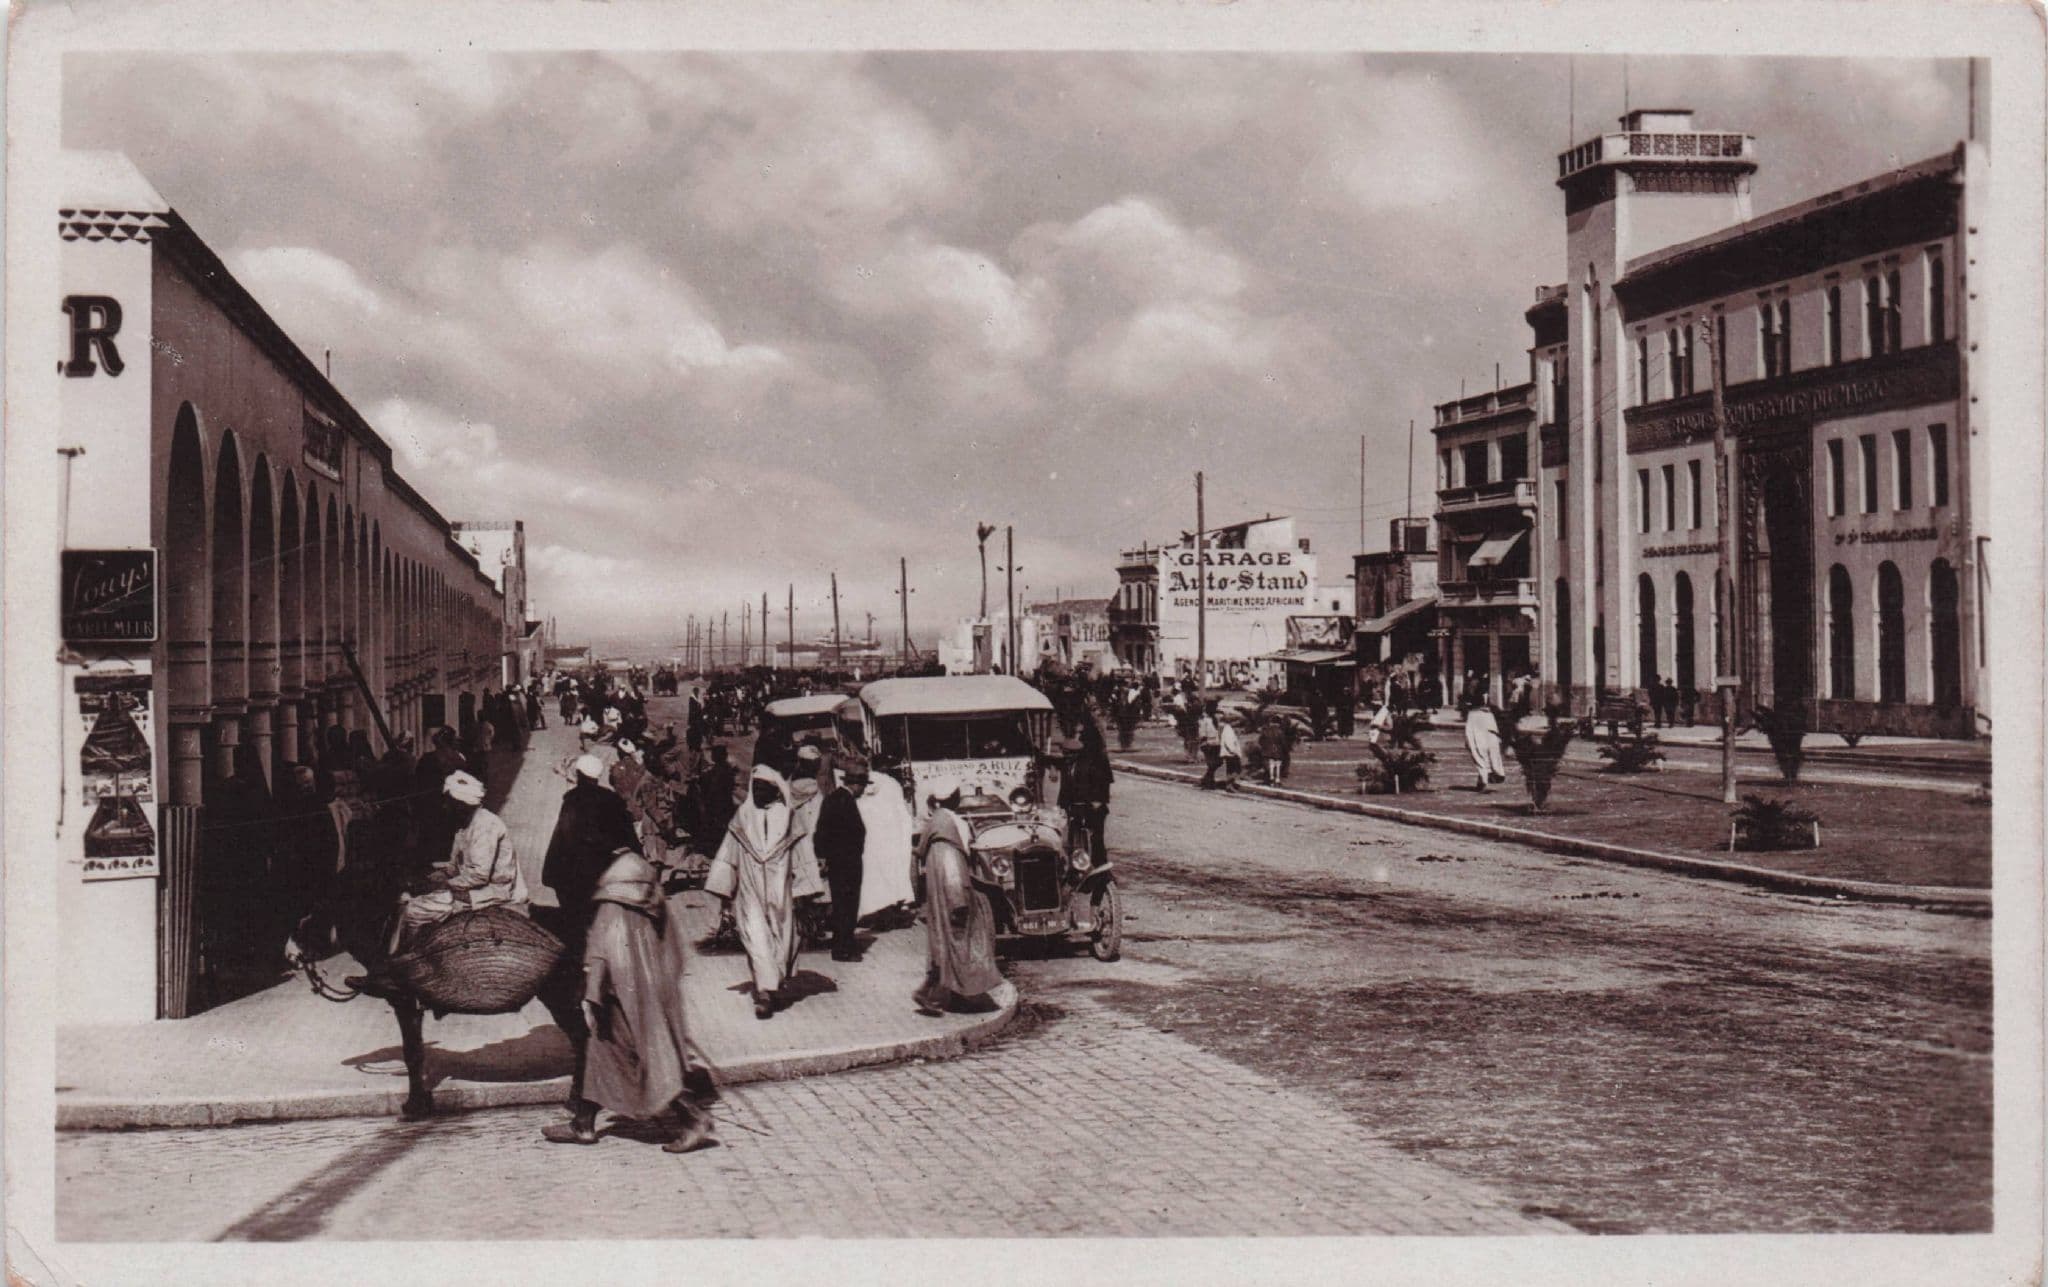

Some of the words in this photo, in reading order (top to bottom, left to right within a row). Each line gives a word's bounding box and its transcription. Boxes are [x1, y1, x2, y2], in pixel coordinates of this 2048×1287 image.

[57, 295, 125, 378] R
[1178, 551, 1292, 566] GARAGE
[1173, 597, 1201, 607] AGENC
